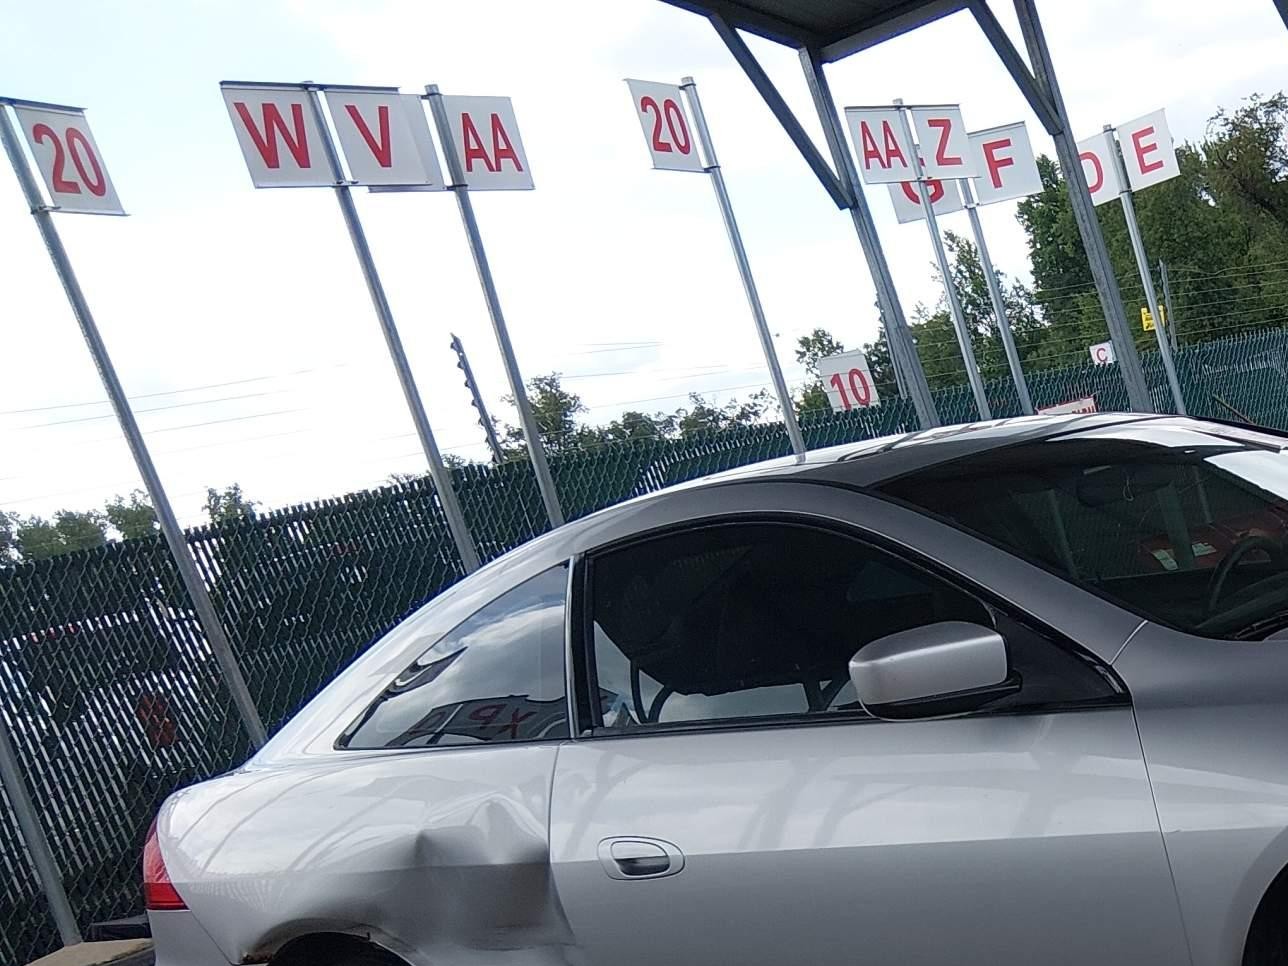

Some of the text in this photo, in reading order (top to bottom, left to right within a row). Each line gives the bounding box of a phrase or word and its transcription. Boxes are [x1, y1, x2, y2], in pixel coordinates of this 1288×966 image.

[233, 102, 311, 169] W
[345, 104, 392, 168] V
[461, 112, 523, 172] AA
[640, 96, 691, 155] 20
[860, 120, 908, 170] AA
[927, 118, 963, 166] Z
[1131, 125, 1164, 175] E
[32, 123, 106, 197] 20
[982, 138, 1014, 189] F
[830, 368, 871, 412] 10
